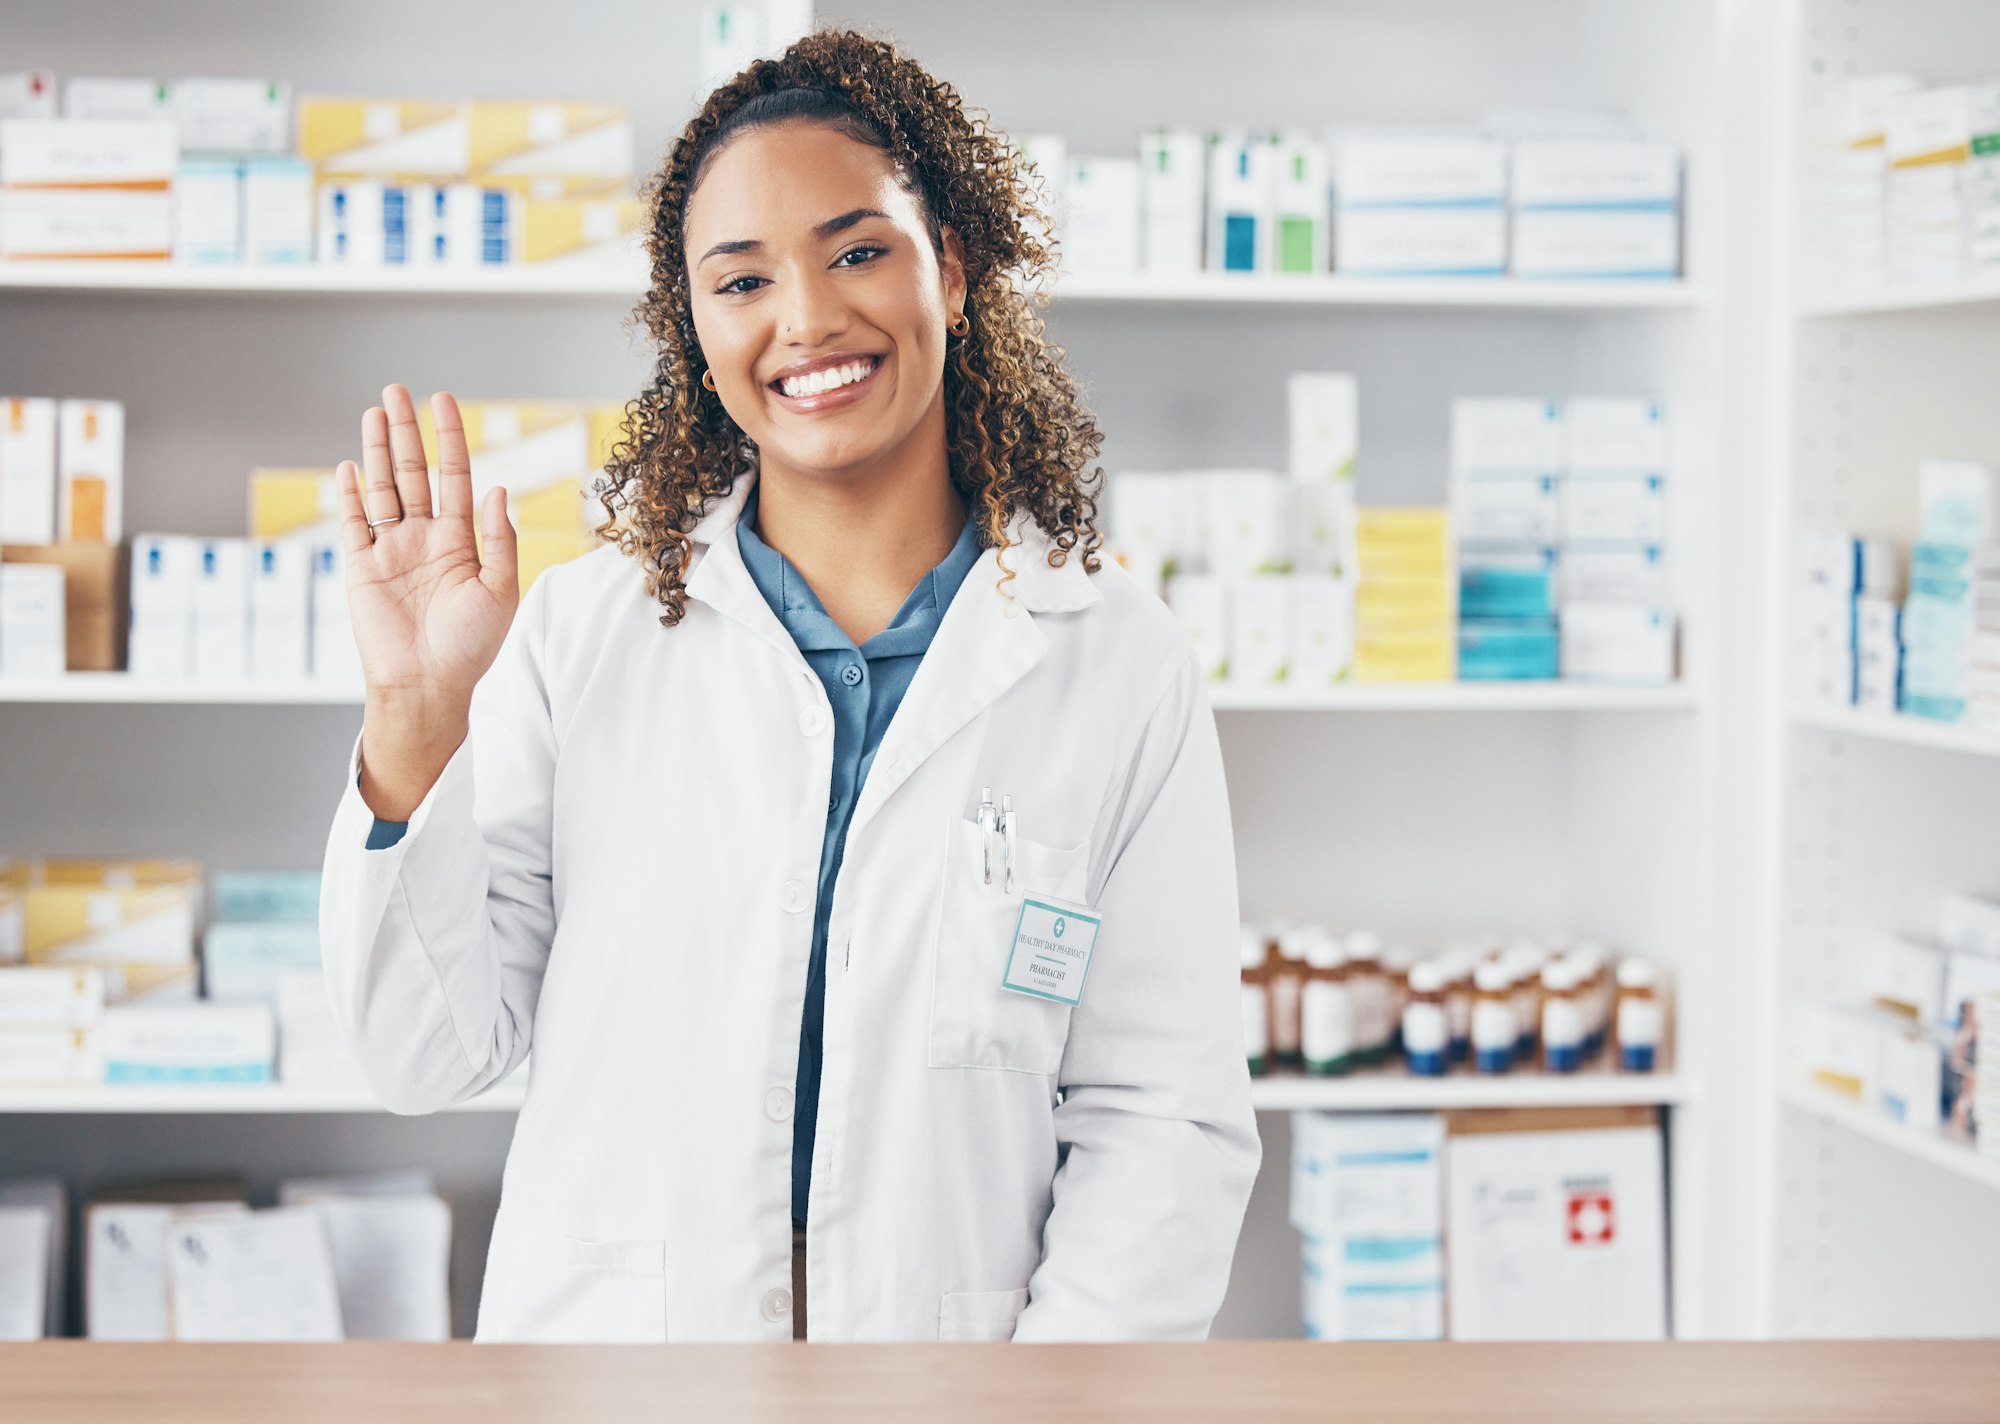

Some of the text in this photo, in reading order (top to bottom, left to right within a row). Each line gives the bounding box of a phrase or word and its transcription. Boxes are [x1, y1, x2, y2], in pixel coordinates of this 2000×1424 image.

[1018, 934, 1086, 960] HEALTHY DAY PHARMACY
[1029, 963, 1066, 980] PHARMACIST
